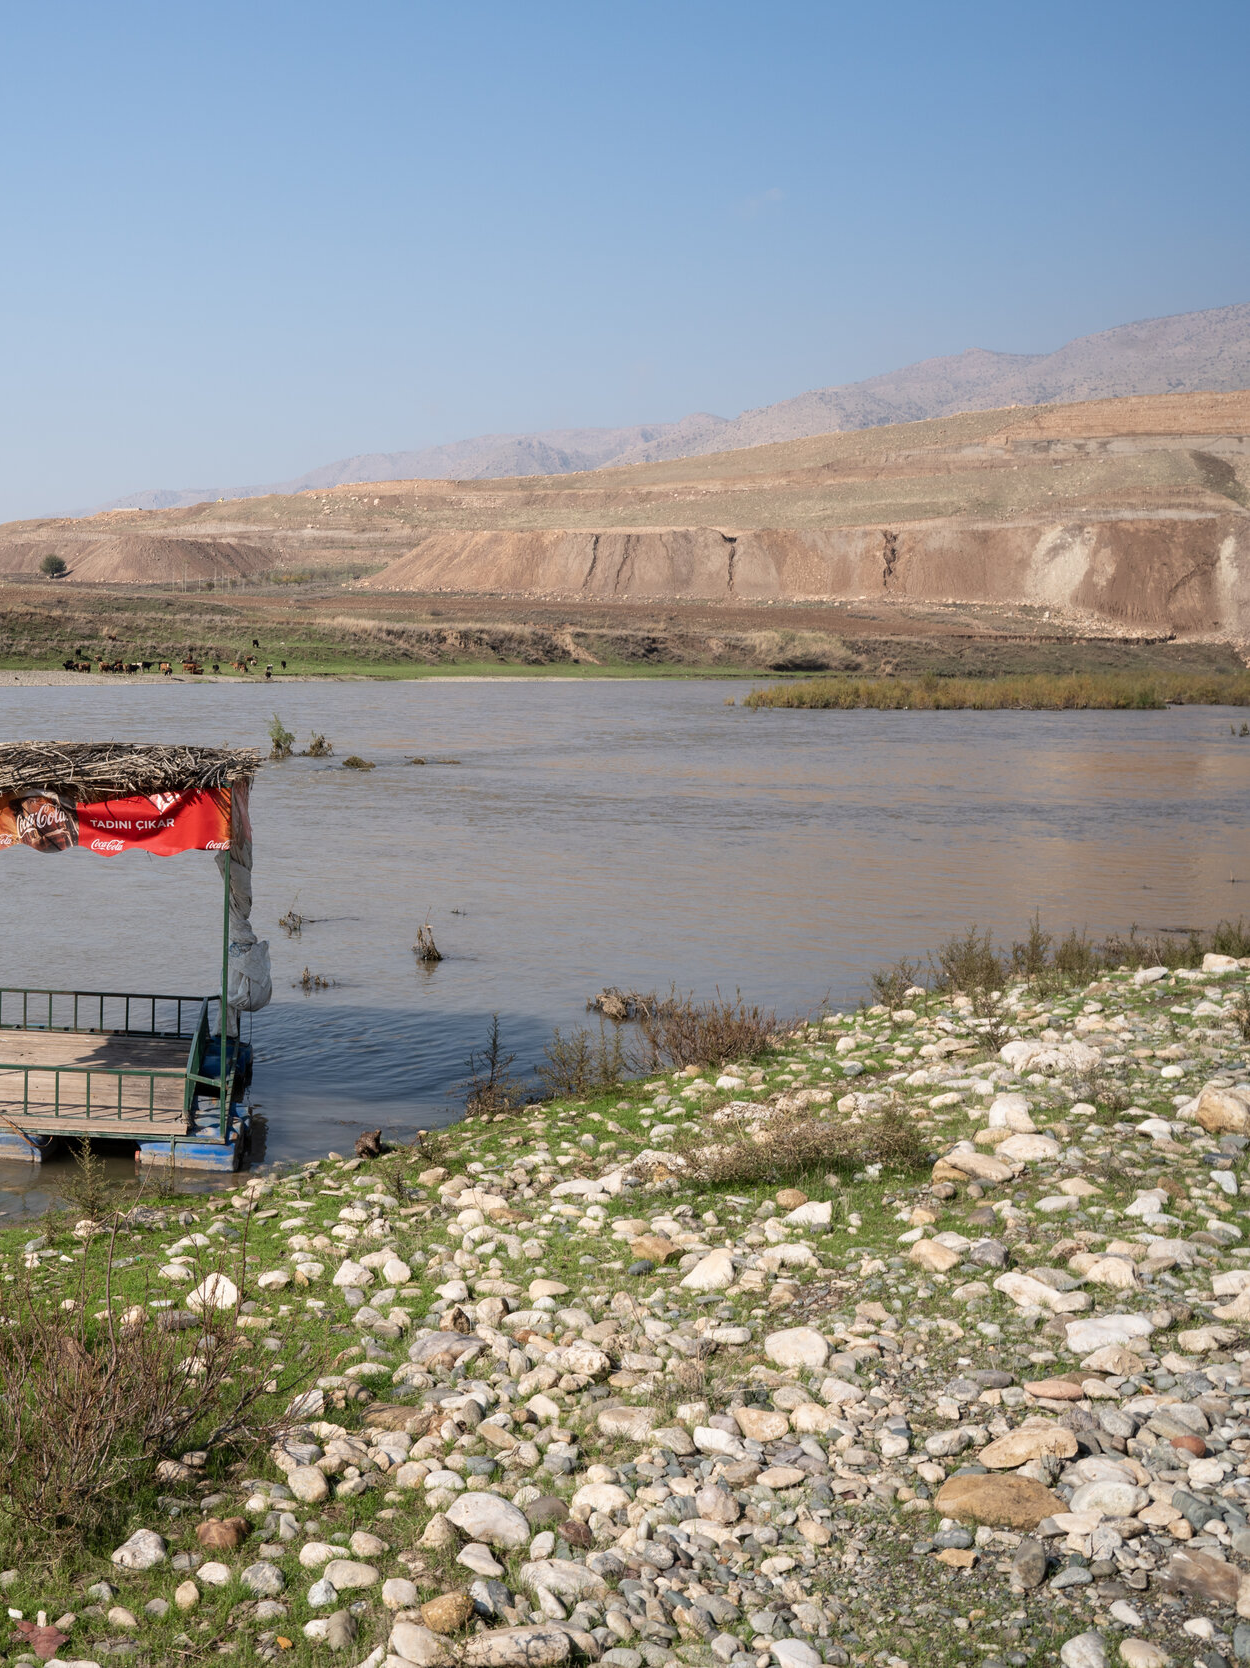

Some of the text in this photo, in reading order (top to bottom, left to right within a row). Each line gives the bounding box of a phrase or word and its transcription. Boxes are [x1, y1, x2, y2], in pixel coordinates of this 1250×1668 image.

[16, 803, 67, 838] Coca-Cola
[90, 818, 175, 831] TADINI ÇIKAR
[91, 839, 125, 851] Coca-Cola
